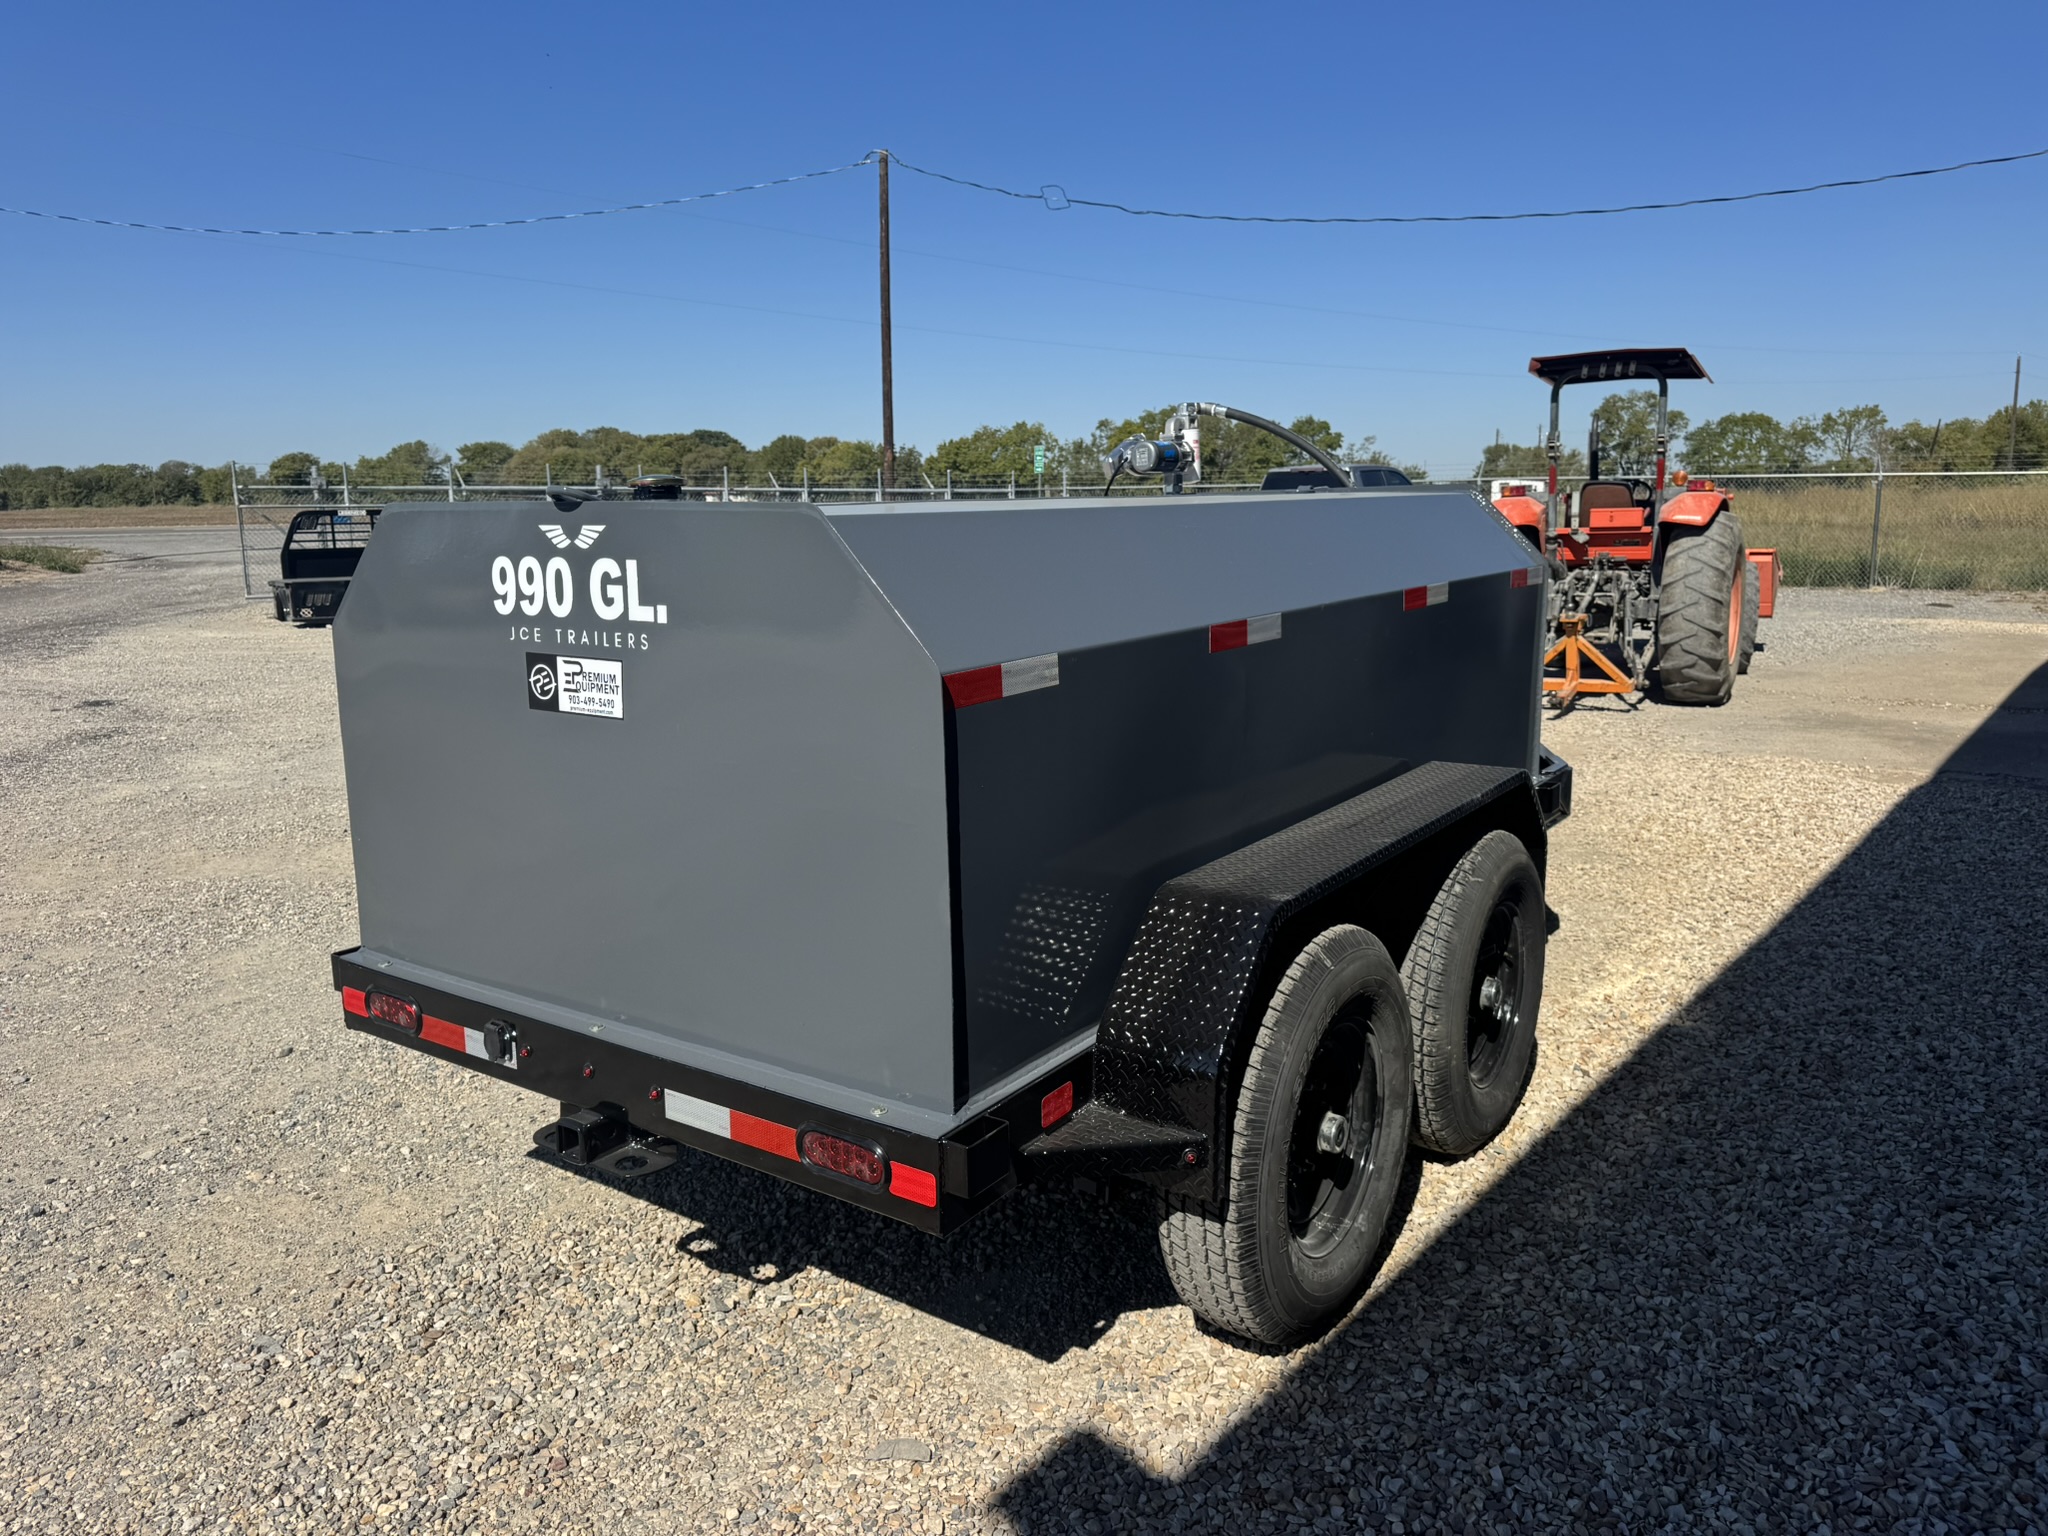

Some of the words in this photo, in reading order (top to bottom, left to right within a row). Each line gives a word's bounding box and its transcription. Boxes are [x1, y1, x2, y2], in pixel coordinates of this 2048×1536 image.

[491, 555, 573, 618] 990
[590, 557, 667, 624] GL.
[510, 626, 542, 642] JCE
[555, 628, 649, 650] TRAILERS
[562, 659, 617, 685] PREMIUM
[563, 671, 620, 696] EQUIPMENT
[568, 694, 615, 709] 903-499-5490
